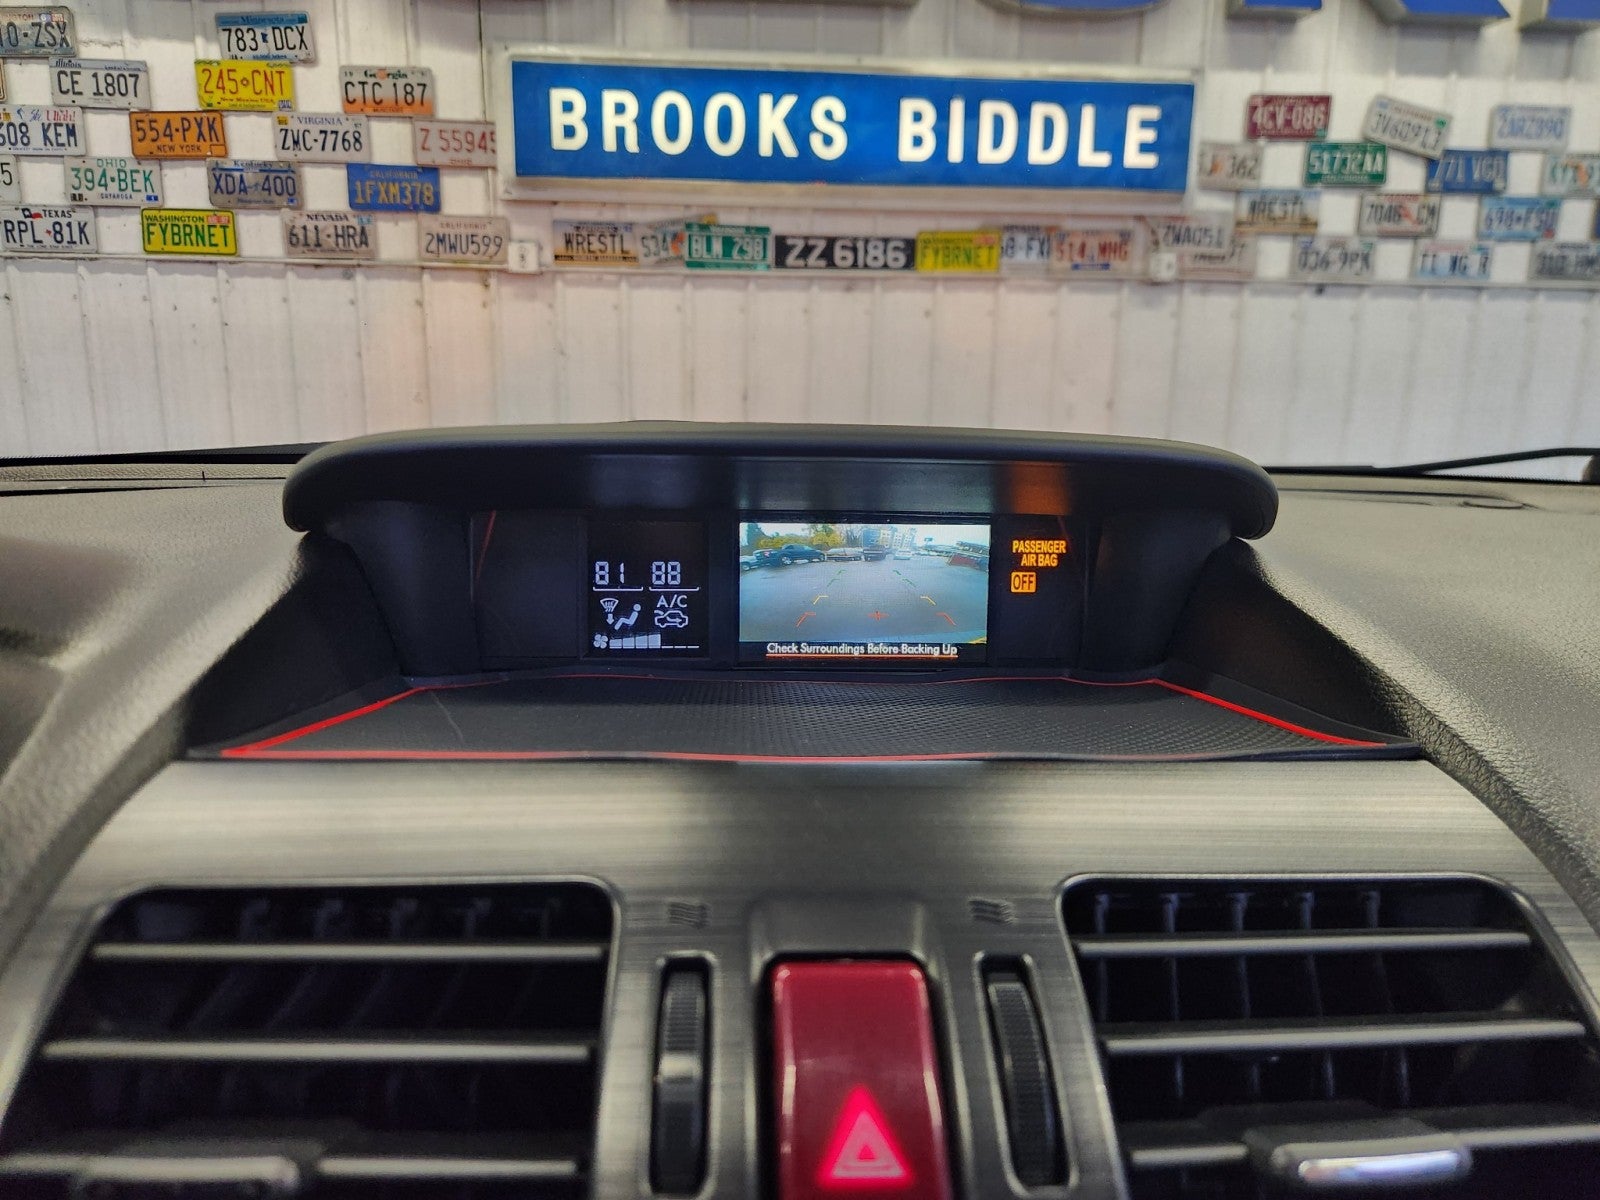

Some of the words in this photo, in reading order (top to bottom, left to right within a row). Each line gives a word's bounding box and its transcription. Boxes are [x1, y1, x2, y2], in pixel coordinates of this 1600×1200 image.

[222, 28, 259, 52] 783
[272, 26, 308, 51] DCX
[55, 59, 82, 68] Illinois
[57, 70, 83, 96] CE
[92, 72, 140, 98] 1807
[202, 68, 239, 95] 245
[251, 69, 285, 96] CNT
[344, 81, 383, 105] CTC
[393, 83, 427, 106] 187
[135, 117, 219, 142] 554-PXK
[297, 116, 342, 125] VIRGINIA
[549, 87, 848, 161] BROOKS
[898, 96, 1162, 169] BIDDLE
[41, 122, 78, 147] KEM
[157, 145, 175, 153] NEW
[180, 145, 202, 153] YORK
[97, 158, 127, 168] OHIO
[213, 173, 247, 197] XDA
[261, 175, 296, 197] 400
[355, 181, 434, 206] 1FXM378
[42, 209, 72, 218] TEXAS
[145, 214, 205, 223] WASHINGTON
[306, 213, 350, 222] NEVADA
[4, 219, 43, 244] RPL
[52, 221, 90, 245] 81K
[147, 224, 229, 248] FYBRNET
[564, 232, 630, 255] WRESTL
[425, 232, 503, 257] 2MWU599
[784, 238, 827, 268] ZZ
[833, 238, 907, 269] 6186
[920, 245, 995, 268] FYBRNET
[1012, 539, 1067, 554] PASSENGER
[1021, 553, 1037, 567] AIR
[1037, 553, 1059, 567] BAG
[595, 561, 625, 585] 81
[652, 561, 681, 585] 88
[1013, 574, 1034, 591] OFF
[656, 594, 688, 608] A/C
[766, 642, 798, 654] Check
[799, 642, 865, 655] Surroundings
[867, 643, 900, 655] Before
[901, 644, 941, 656] Backing
[942, 644, 958, 656] Up
